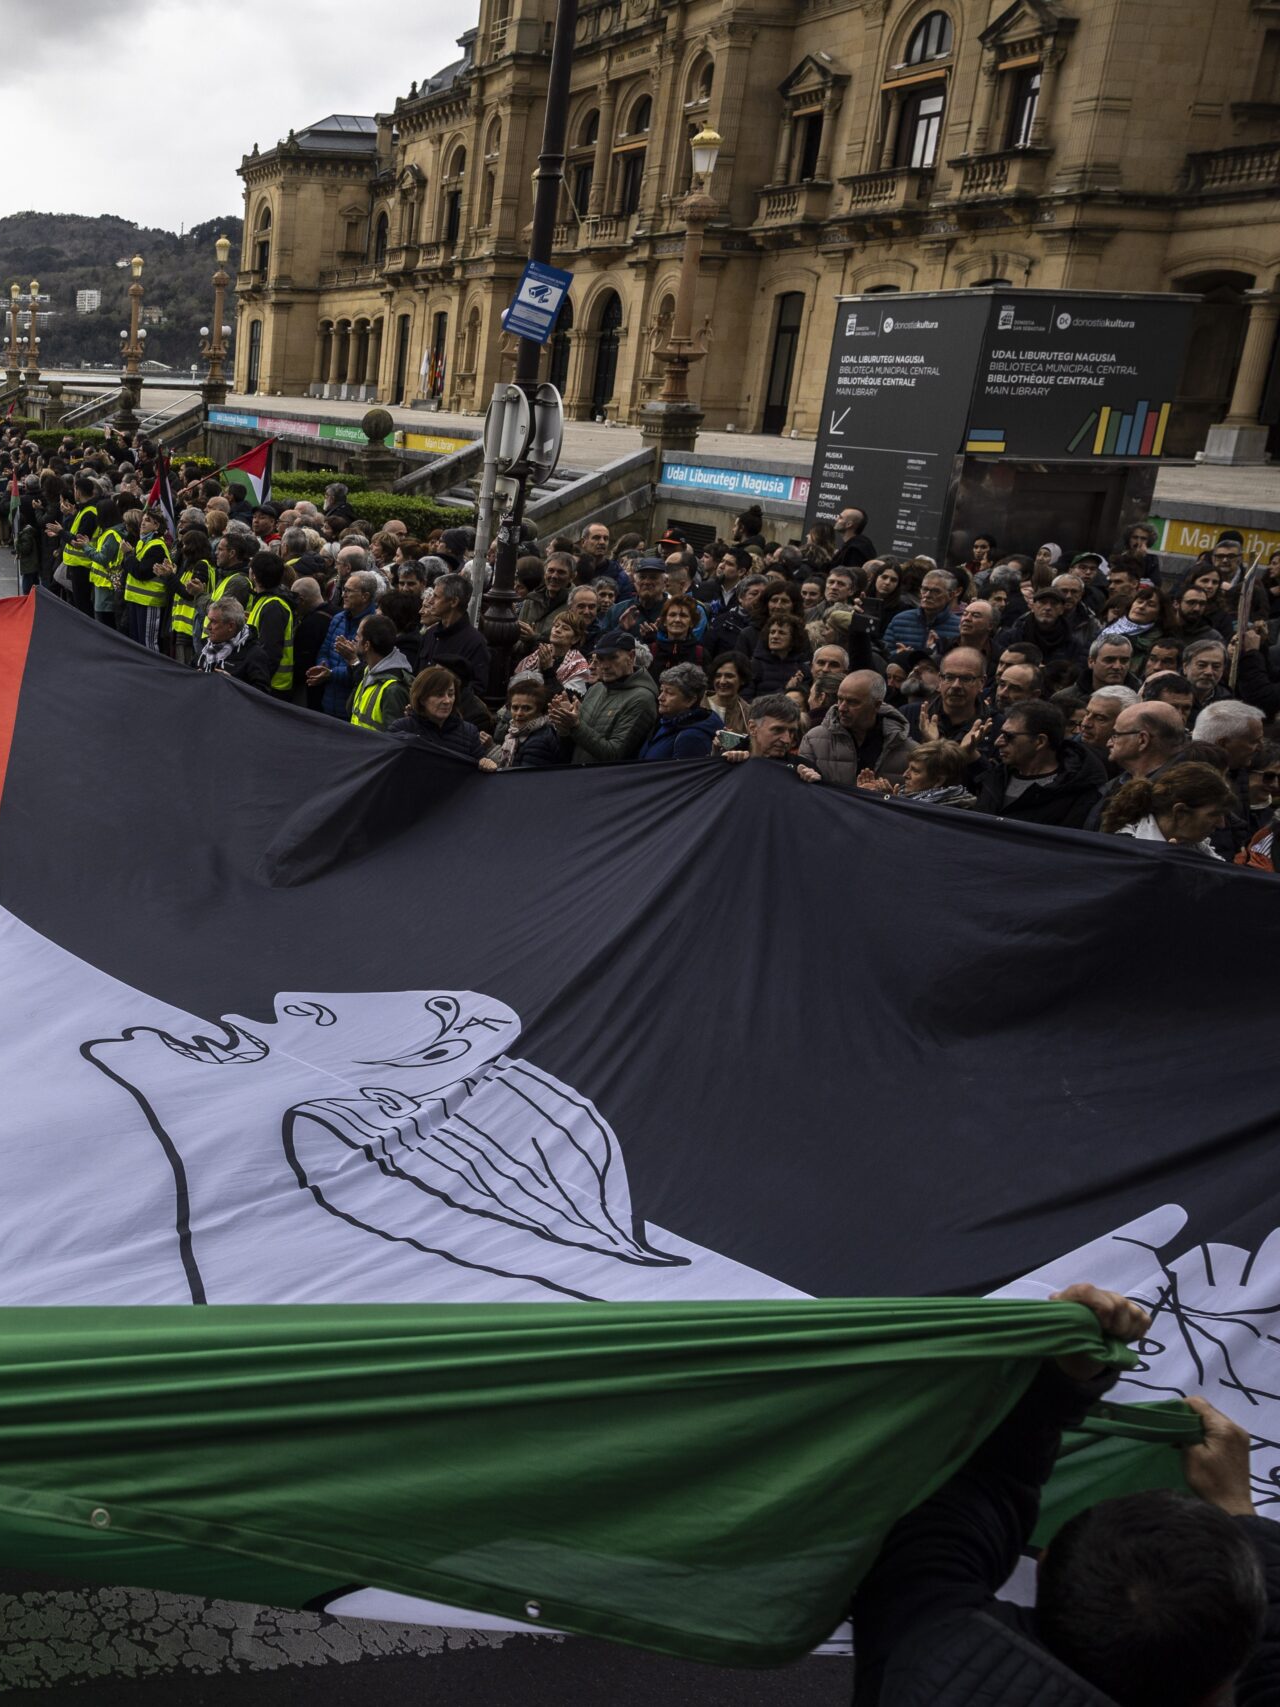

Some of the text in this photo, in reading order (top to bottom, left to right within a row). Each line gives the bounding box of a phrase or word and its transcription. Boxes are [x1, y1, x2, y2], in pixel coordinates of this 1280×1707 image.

[1072, 318, 1136, 329] donostiakultura
[841, 355, 925, 364] UDAL LIBURUTEGI NAGUSIA
[991, 350, 1117, 362] UDAL LIBURUTEGI NAGUSIA
[839, 365, 941, 376] BIBLIOTECA MUNICIPAL CENTRAL
[989, 362, 1139, 375] BIBLIOTECA MUNICIPAL CENTRAL
[882, 377, 916, 387] CENTRALE
[987, 373, 1105, 386] BIBLIOTHÈQUE CENTRALE
[836, 387, 879, 397] MAIN LIBRARY
[985, 386, 1051, 396] MAIN LIBRARY
[425, 438, 455, 451] Main Library
[825, 451, 843, 459] MUSIKA
[823, 463, 855, 472] ALDIZKARIAK
[666, 466, 784, 494] Udal Liburutegi Nagusia
[820, 482, 849, 491] LITERATURA
[818, 493, 842, 501] KOMIKIAK
[1180, 527, 1218, 550] Mai
